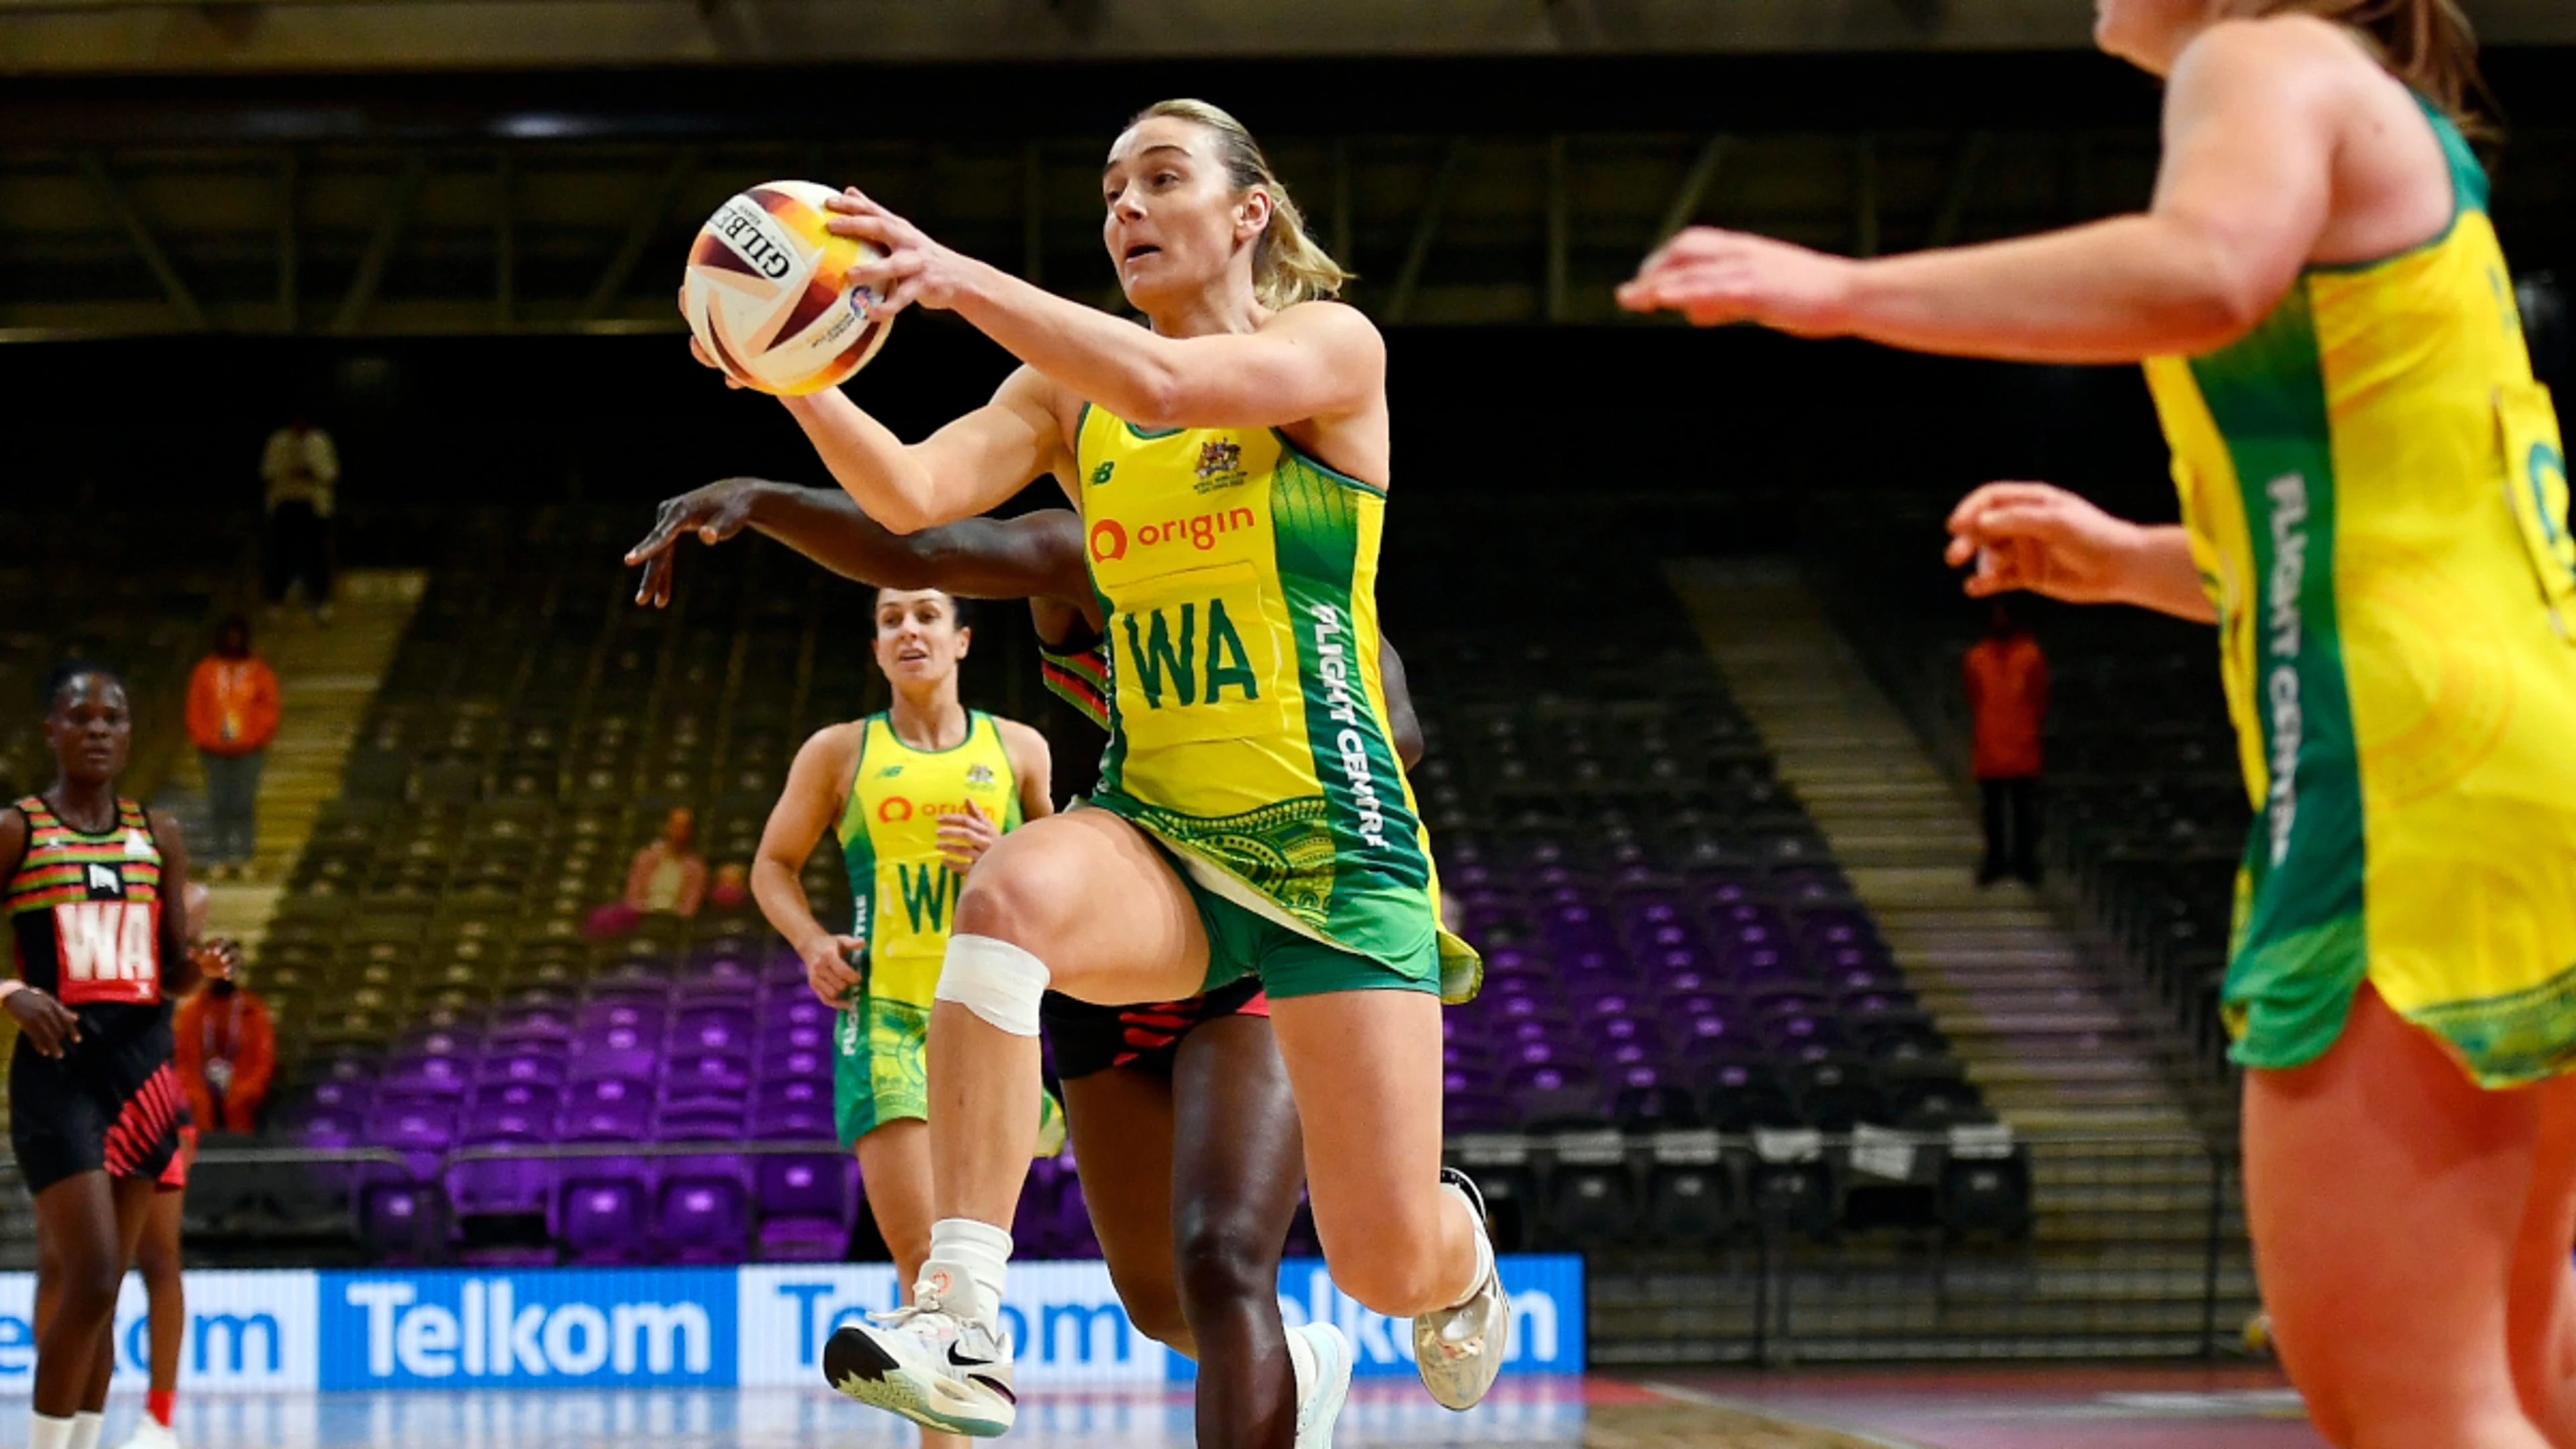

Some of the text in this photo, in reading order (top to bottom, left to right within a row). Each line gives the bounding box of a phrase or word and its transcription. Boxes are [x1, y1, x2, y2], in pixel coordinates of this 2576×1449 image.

[1138, 507, 1254, 550] origin
[1123, 599, 1259, 710] WA
[55, 902, 155, 981] WA
[345, 1277, 712, 1377] Telkom
